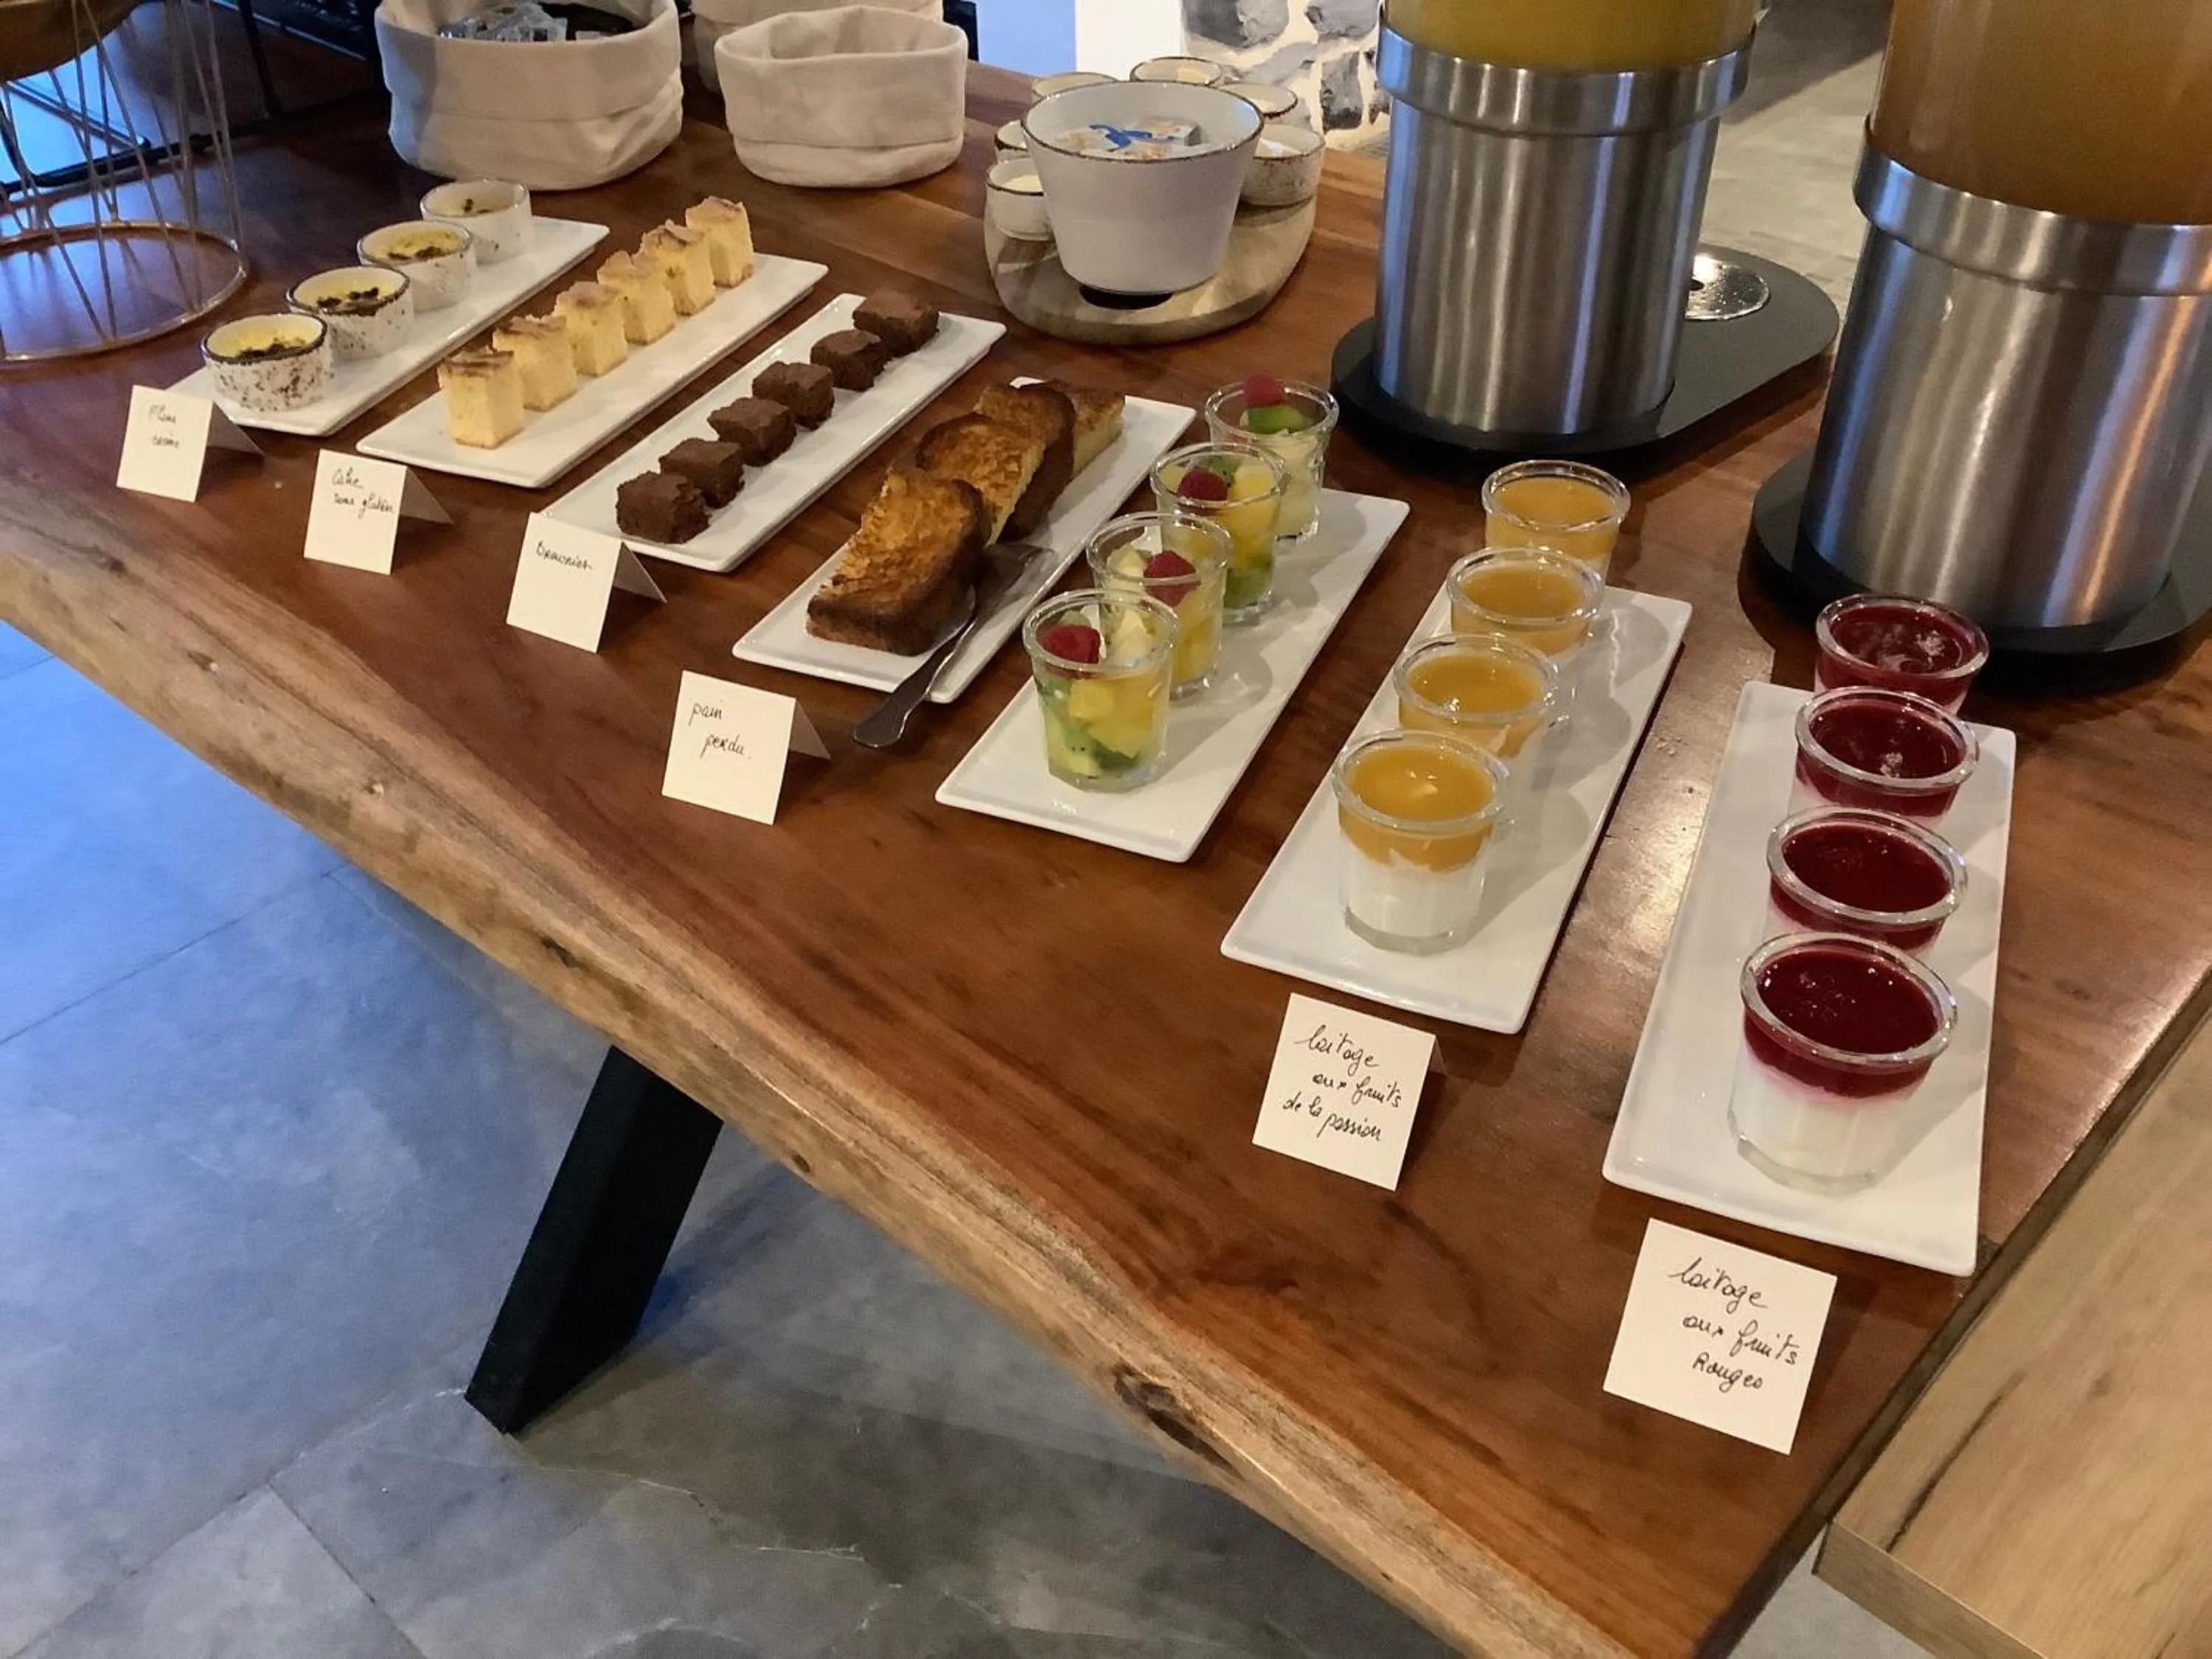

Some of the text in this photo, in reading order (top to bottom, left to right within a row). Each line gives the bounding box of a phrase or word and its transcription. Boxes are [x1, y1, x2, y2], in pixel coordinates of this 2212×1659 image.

[688, 699, 723, 727] pain
[1312, 1073, 1402, 1108] aux fruits
[1282, 1091, 1382, 1142] de la passion
[1682, 1315, 1801, 1366] aux fruits
